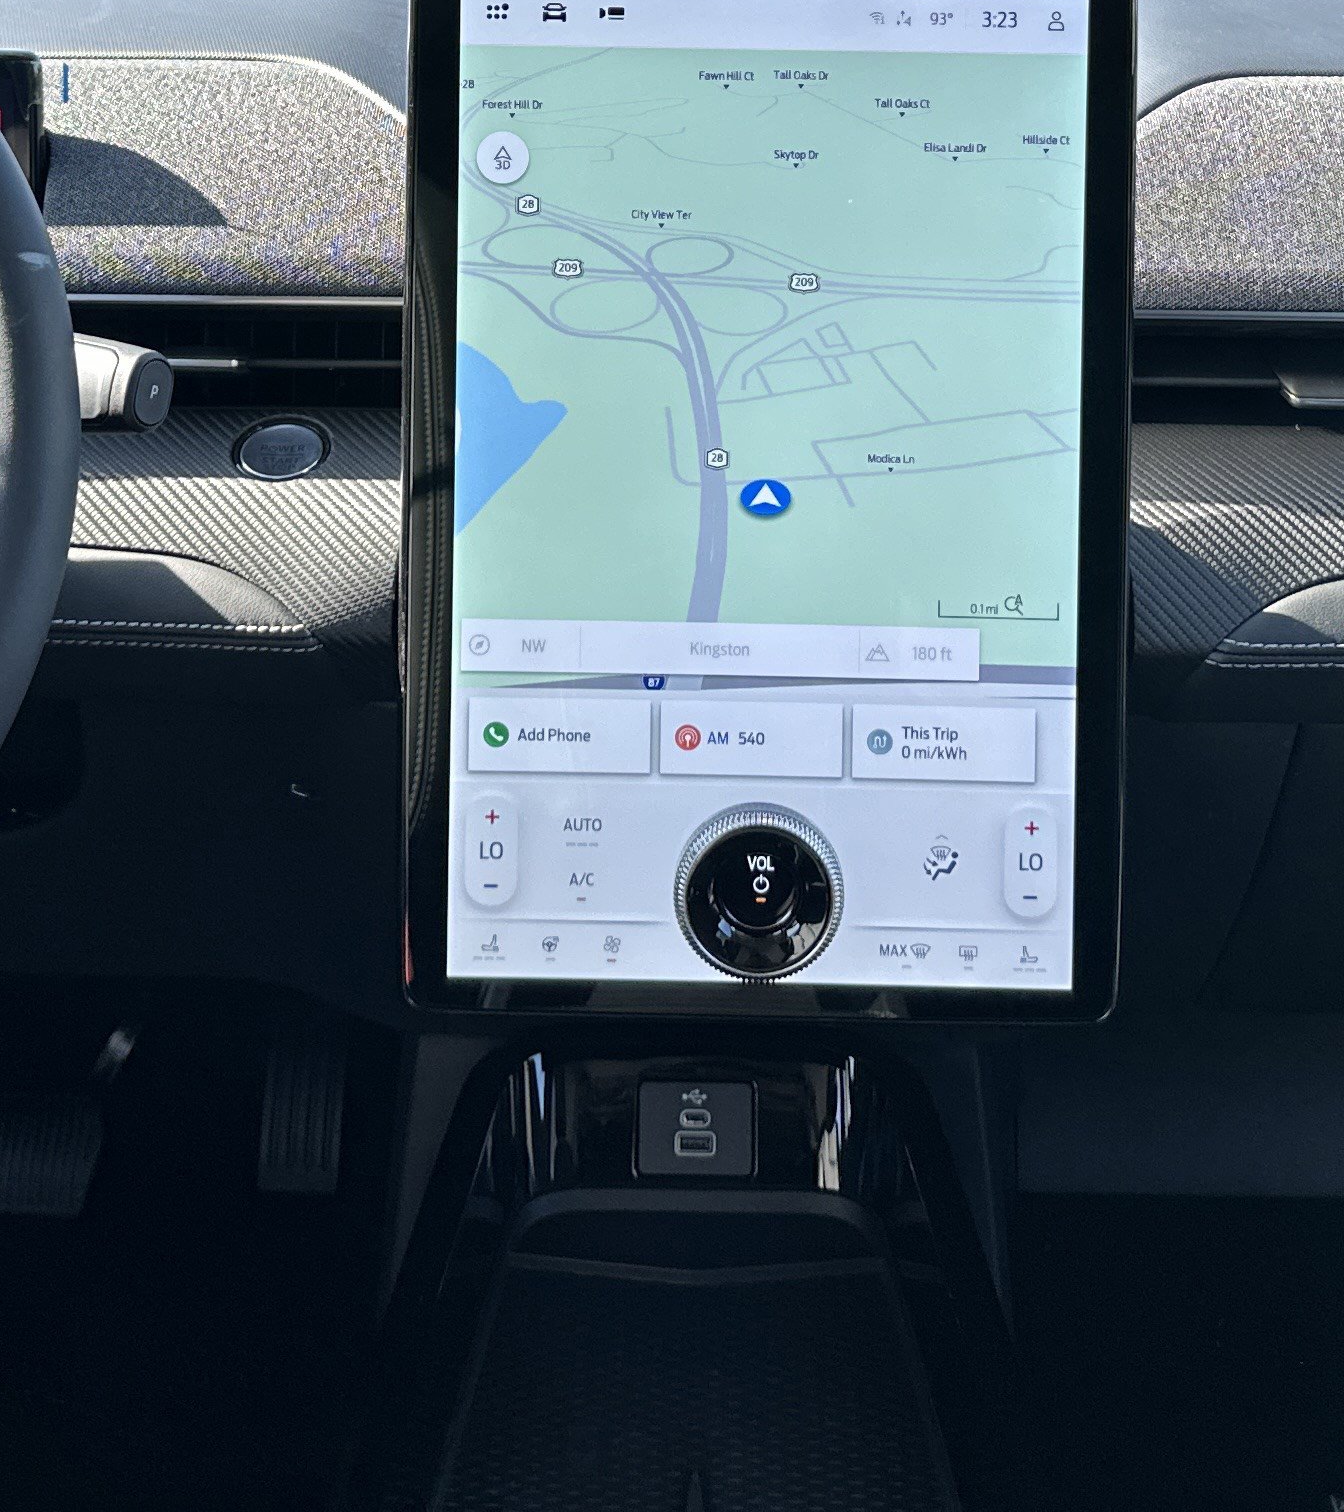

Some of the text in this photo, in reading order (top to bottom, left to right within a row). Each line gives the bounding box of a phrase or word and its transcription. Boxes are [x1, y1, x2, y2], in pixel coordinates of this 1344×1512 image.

[982, 11, 1018, 28] 3:23
[699, 71, 754, 81] Fawn Hill Ct
[774, 70, 828, 80] Tall Oaks Dr
[482, 100, 543, 109] Forest Hill Dr
[875, 98, 930, 108] Tall Oaks Ct
[1023, 135, 1070, 145] Hillside Ct
[924, 143, 987, 152] Elisa Landi Dr
[774, 150, 819, 160] Skytop Dr
[495, 160, 511, 170] 3D
[522, 199, 535, 209] 28
[631, 209, 692, 221] City View Ter
[558, 262, 578, 273] 209
[794, 277, 814, 287] 209
[150, 385, 159, 399] P
[260, 443, 305, 453] POWER
[711, 453, 723, 462] 28
[868, 454, 914, 464] Modica Ln
[522, 638, 547, 653] NW
[689, 641, 751, 658] Kingston
[913, 647, 952, 661] 180 ft
[517, 727, 591, 743] Add Phone
[706, 732, 765, 746] AM 540
[902, 726, 958, 742] This Trip
[902, 746, 967, 760] 0 mi/kWh
[563, 817, 603, 833] AUTO
[479, 841, 504, 861] LO
[747, 855, 774, 872] VOL
[1018, 853, 1043, 872] LO
[569, 871, 595, 888] A/C
[879, 943, 908, 958] MAX
